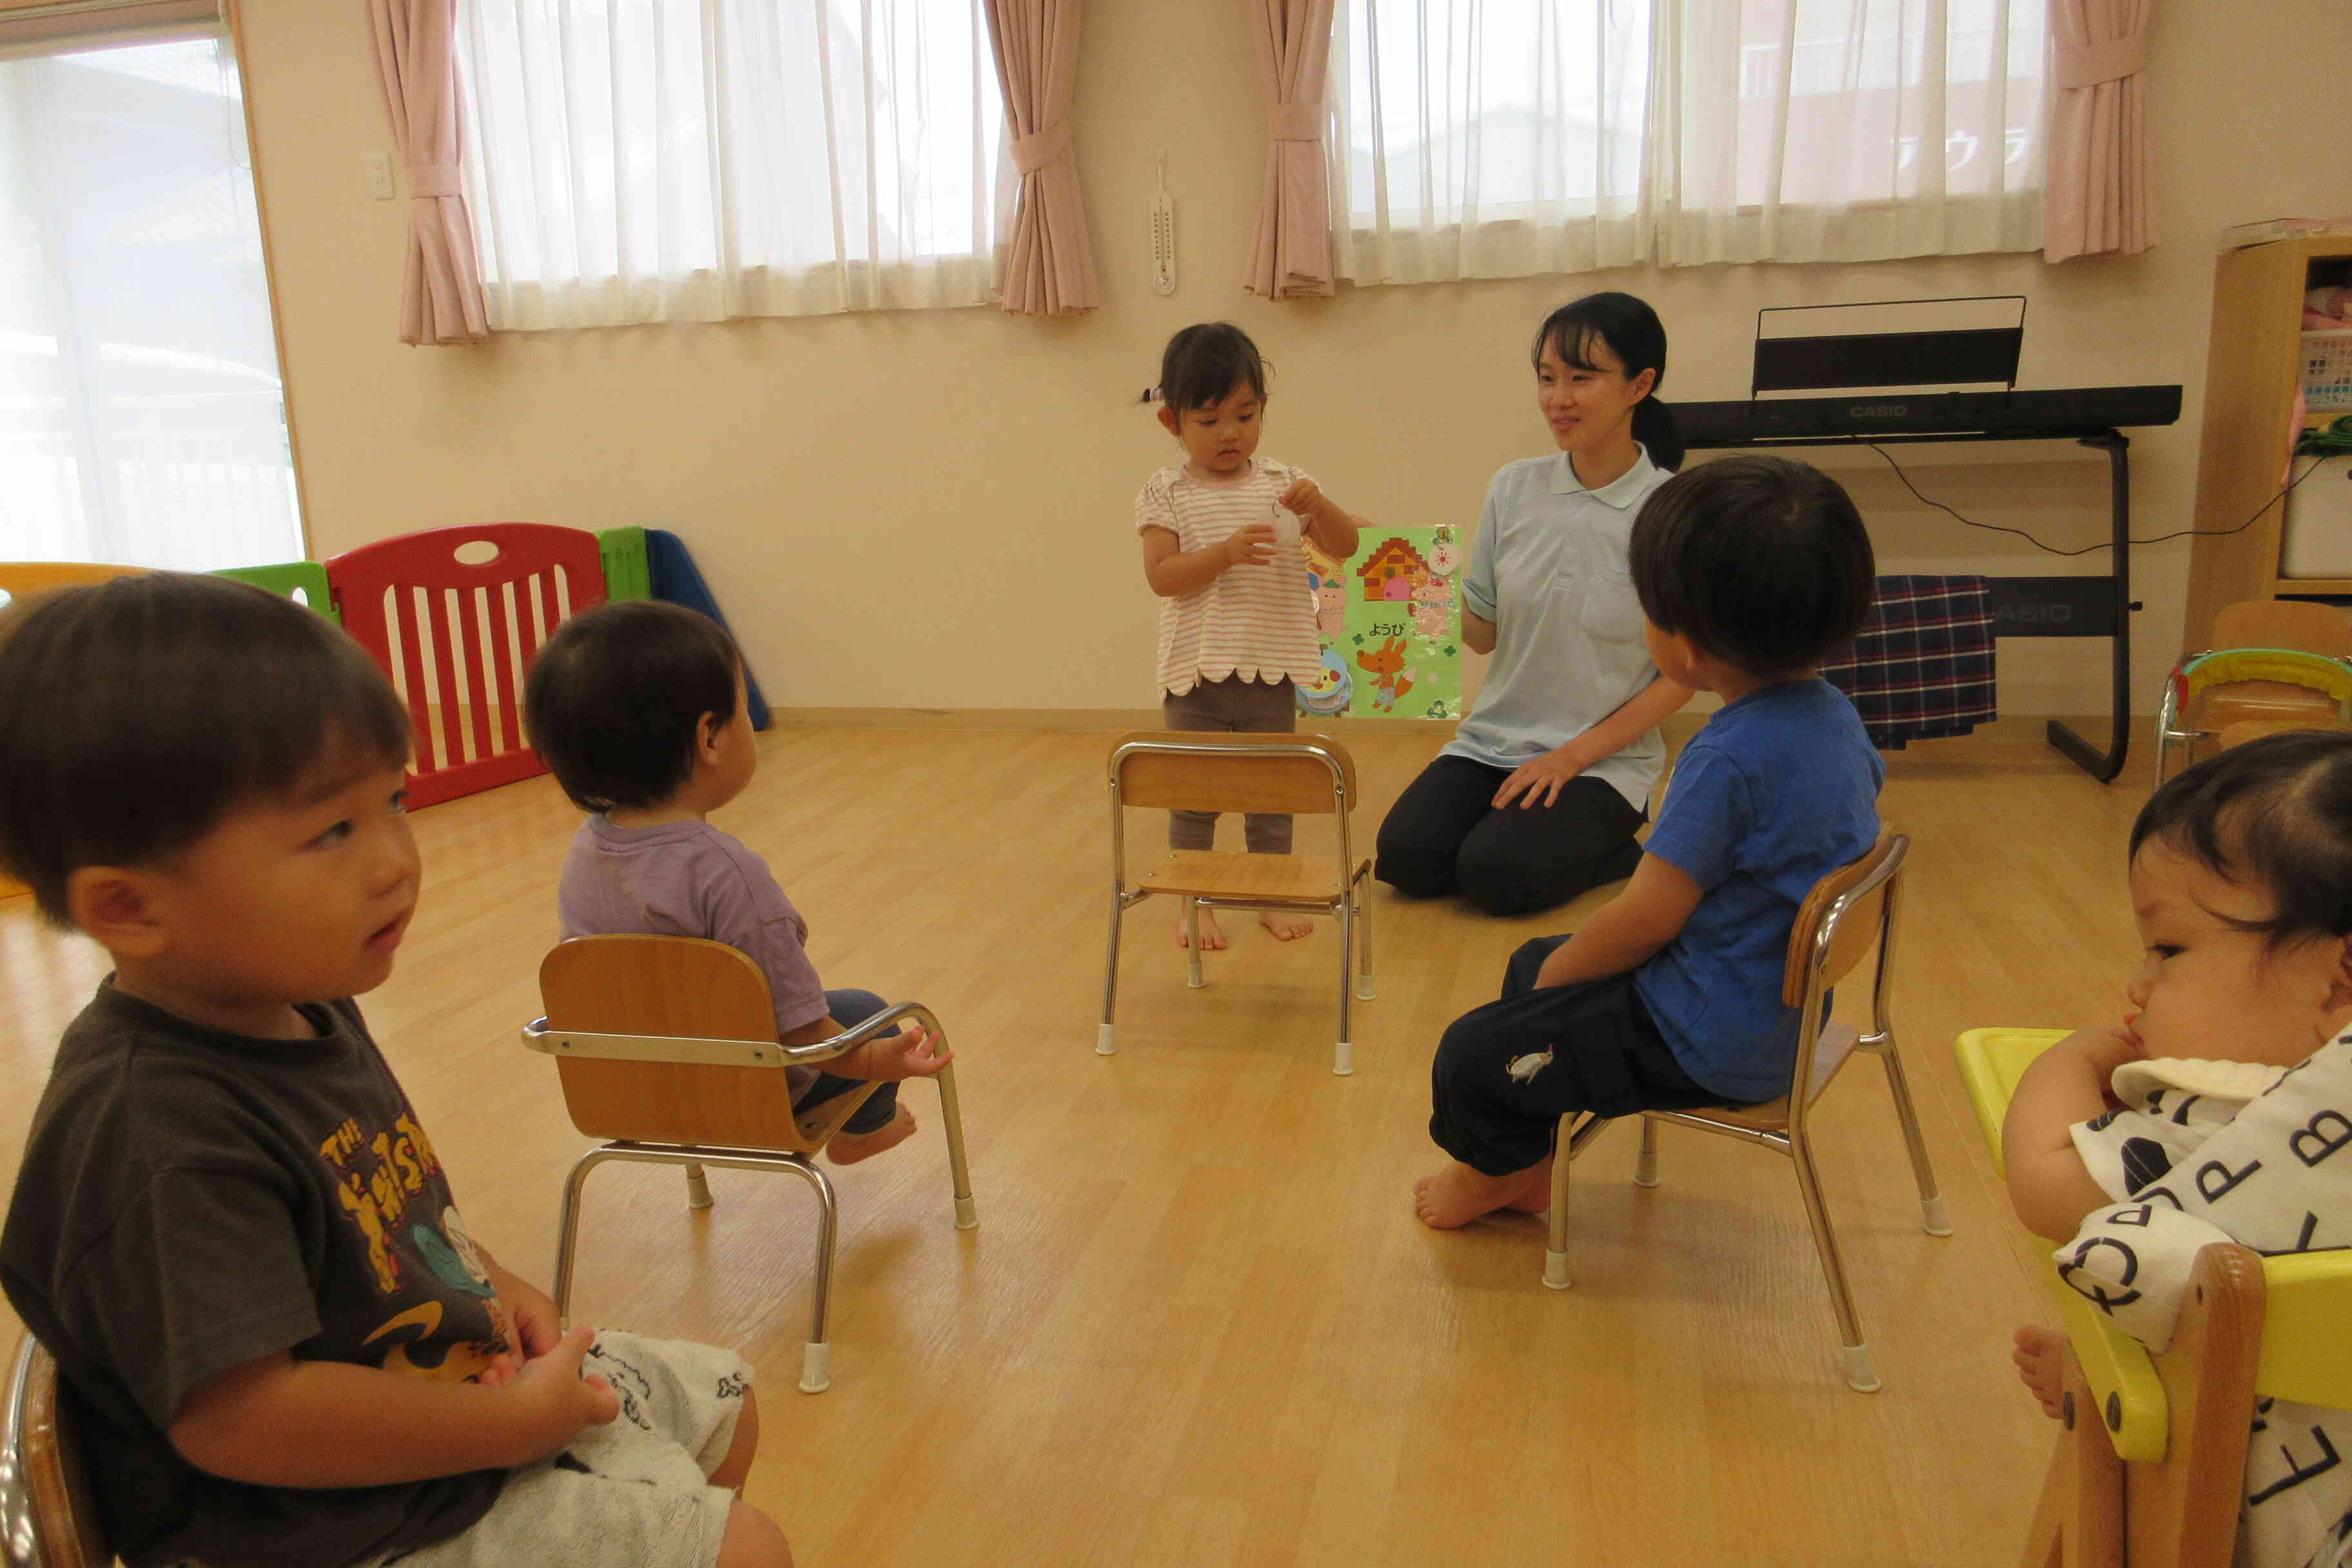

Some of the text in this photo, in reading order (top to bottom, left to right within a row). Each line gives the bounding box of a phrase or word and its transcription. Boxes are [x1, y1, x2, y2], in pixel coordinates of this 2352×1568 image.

[1849, 405, 1908, 418] CASIO
[1994, 603, 2072, 622] ASIO
[1369, 623, 1407, 636] ようび
